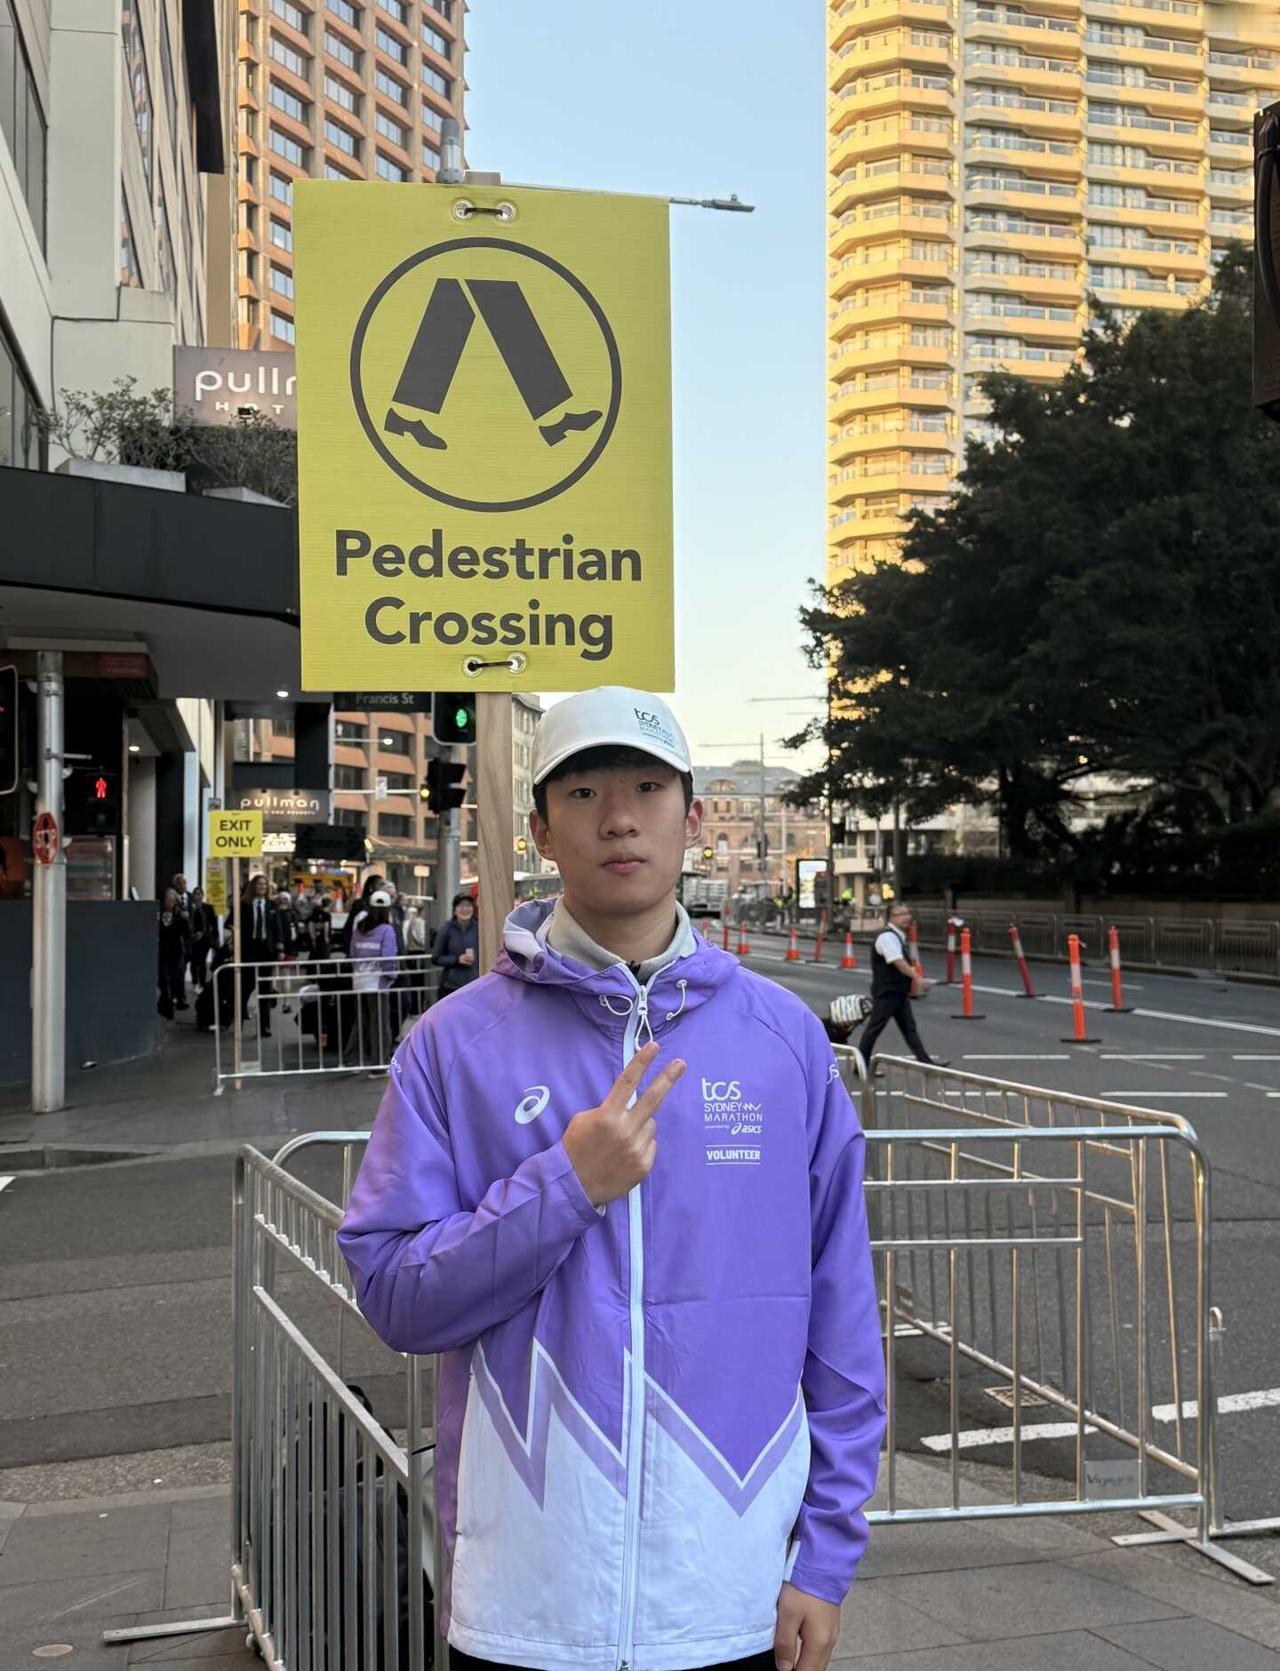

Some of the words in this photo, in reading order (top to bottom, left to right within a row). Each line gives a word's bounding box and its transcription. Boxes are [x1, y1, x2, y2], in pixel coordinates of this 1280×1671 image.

[335, 529, 642, 581] Pedestrian
[365, 597, 613, 661] Crossing
[356, 692, 399, 704] Francis
[401, 692, 415, 704] St
[634, 707, 660, 725] tcs
[240, 796, 319, 811] pullman
[220, 820, 252, 831] EXIT
[216, 836, 255, 847] ONLY
[702, 1078, 741, 1101] tcs
[704, 1102, 742, 1112] SYDNEY
[704, 1113, 763, 1122] MARATHON
[706, 1150, 761, 1161] VOLUNTEER
